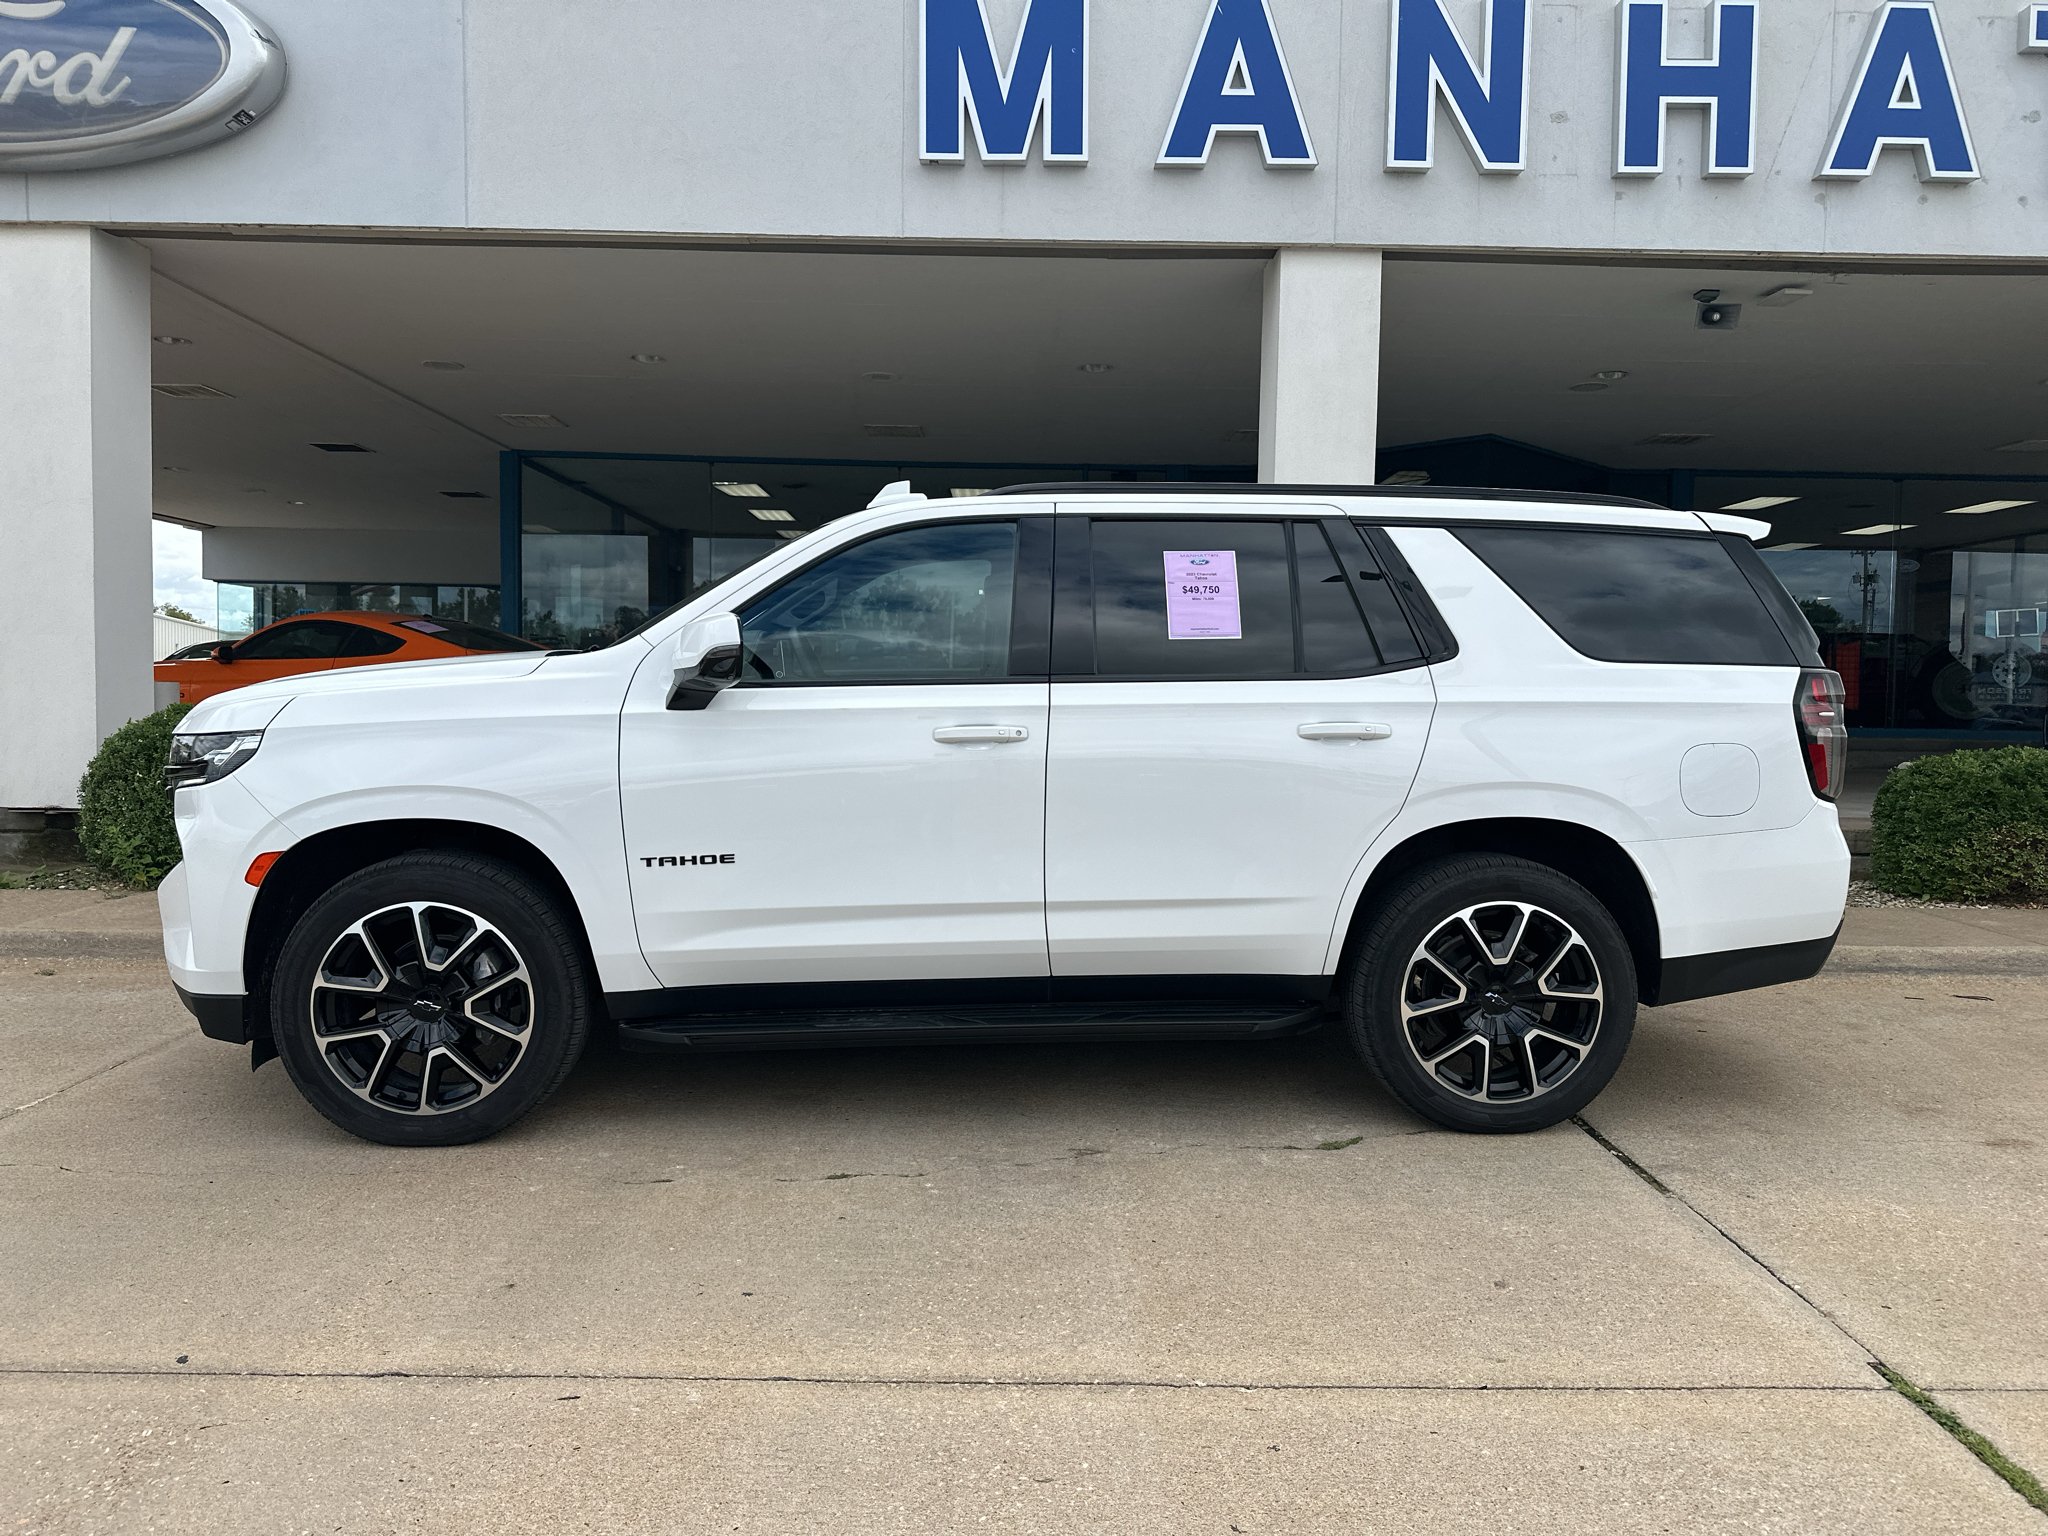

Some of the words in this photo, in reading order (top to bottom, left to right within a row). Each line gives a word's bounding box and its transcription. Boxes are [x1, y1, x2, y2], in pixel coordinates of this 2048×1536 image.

[919, 0, 2048, 183] MANHA
[1182, 585, 1220, 595] $49,750
[640, 854, 735, 867] TAHOE
